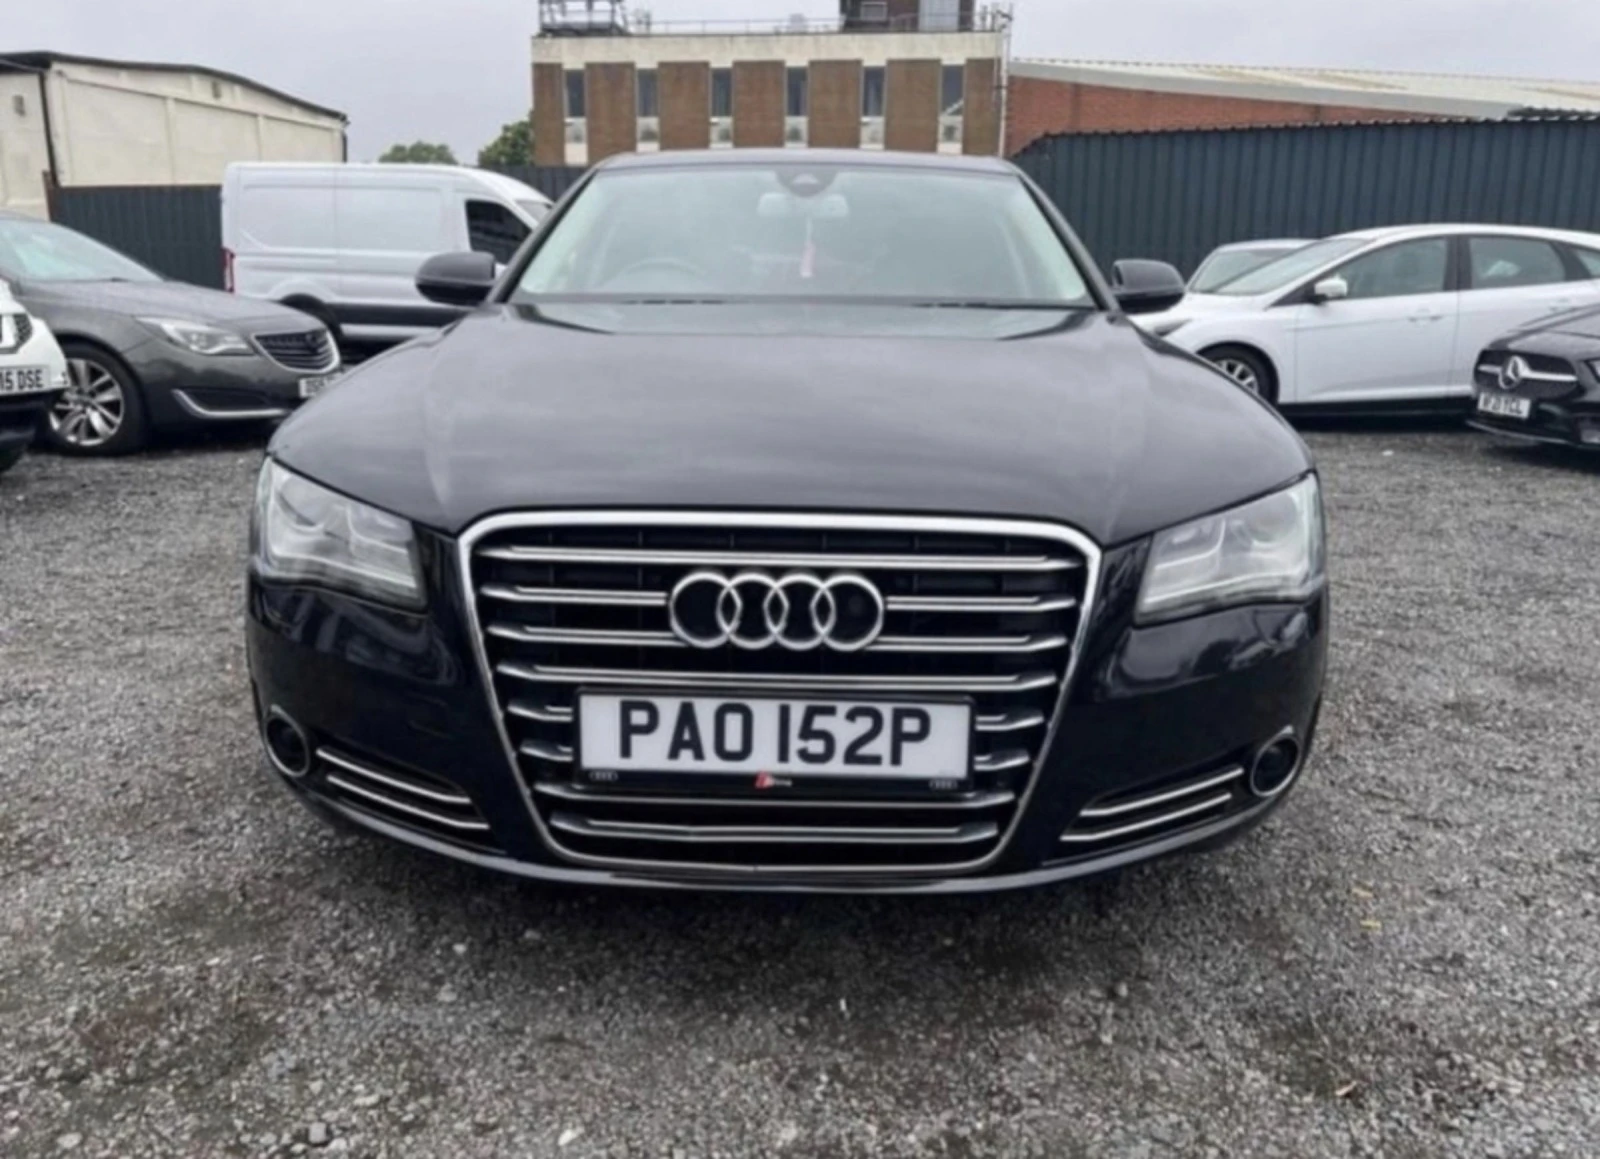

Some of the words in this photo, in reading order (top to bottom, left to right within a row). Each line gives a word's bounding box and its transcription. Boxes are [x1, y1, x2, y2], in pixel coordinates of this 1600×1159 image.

[17, 368, 44, 391] DSE
[619, 699, 754, 762] PAO
[777, 702, 932, 767] 152P
